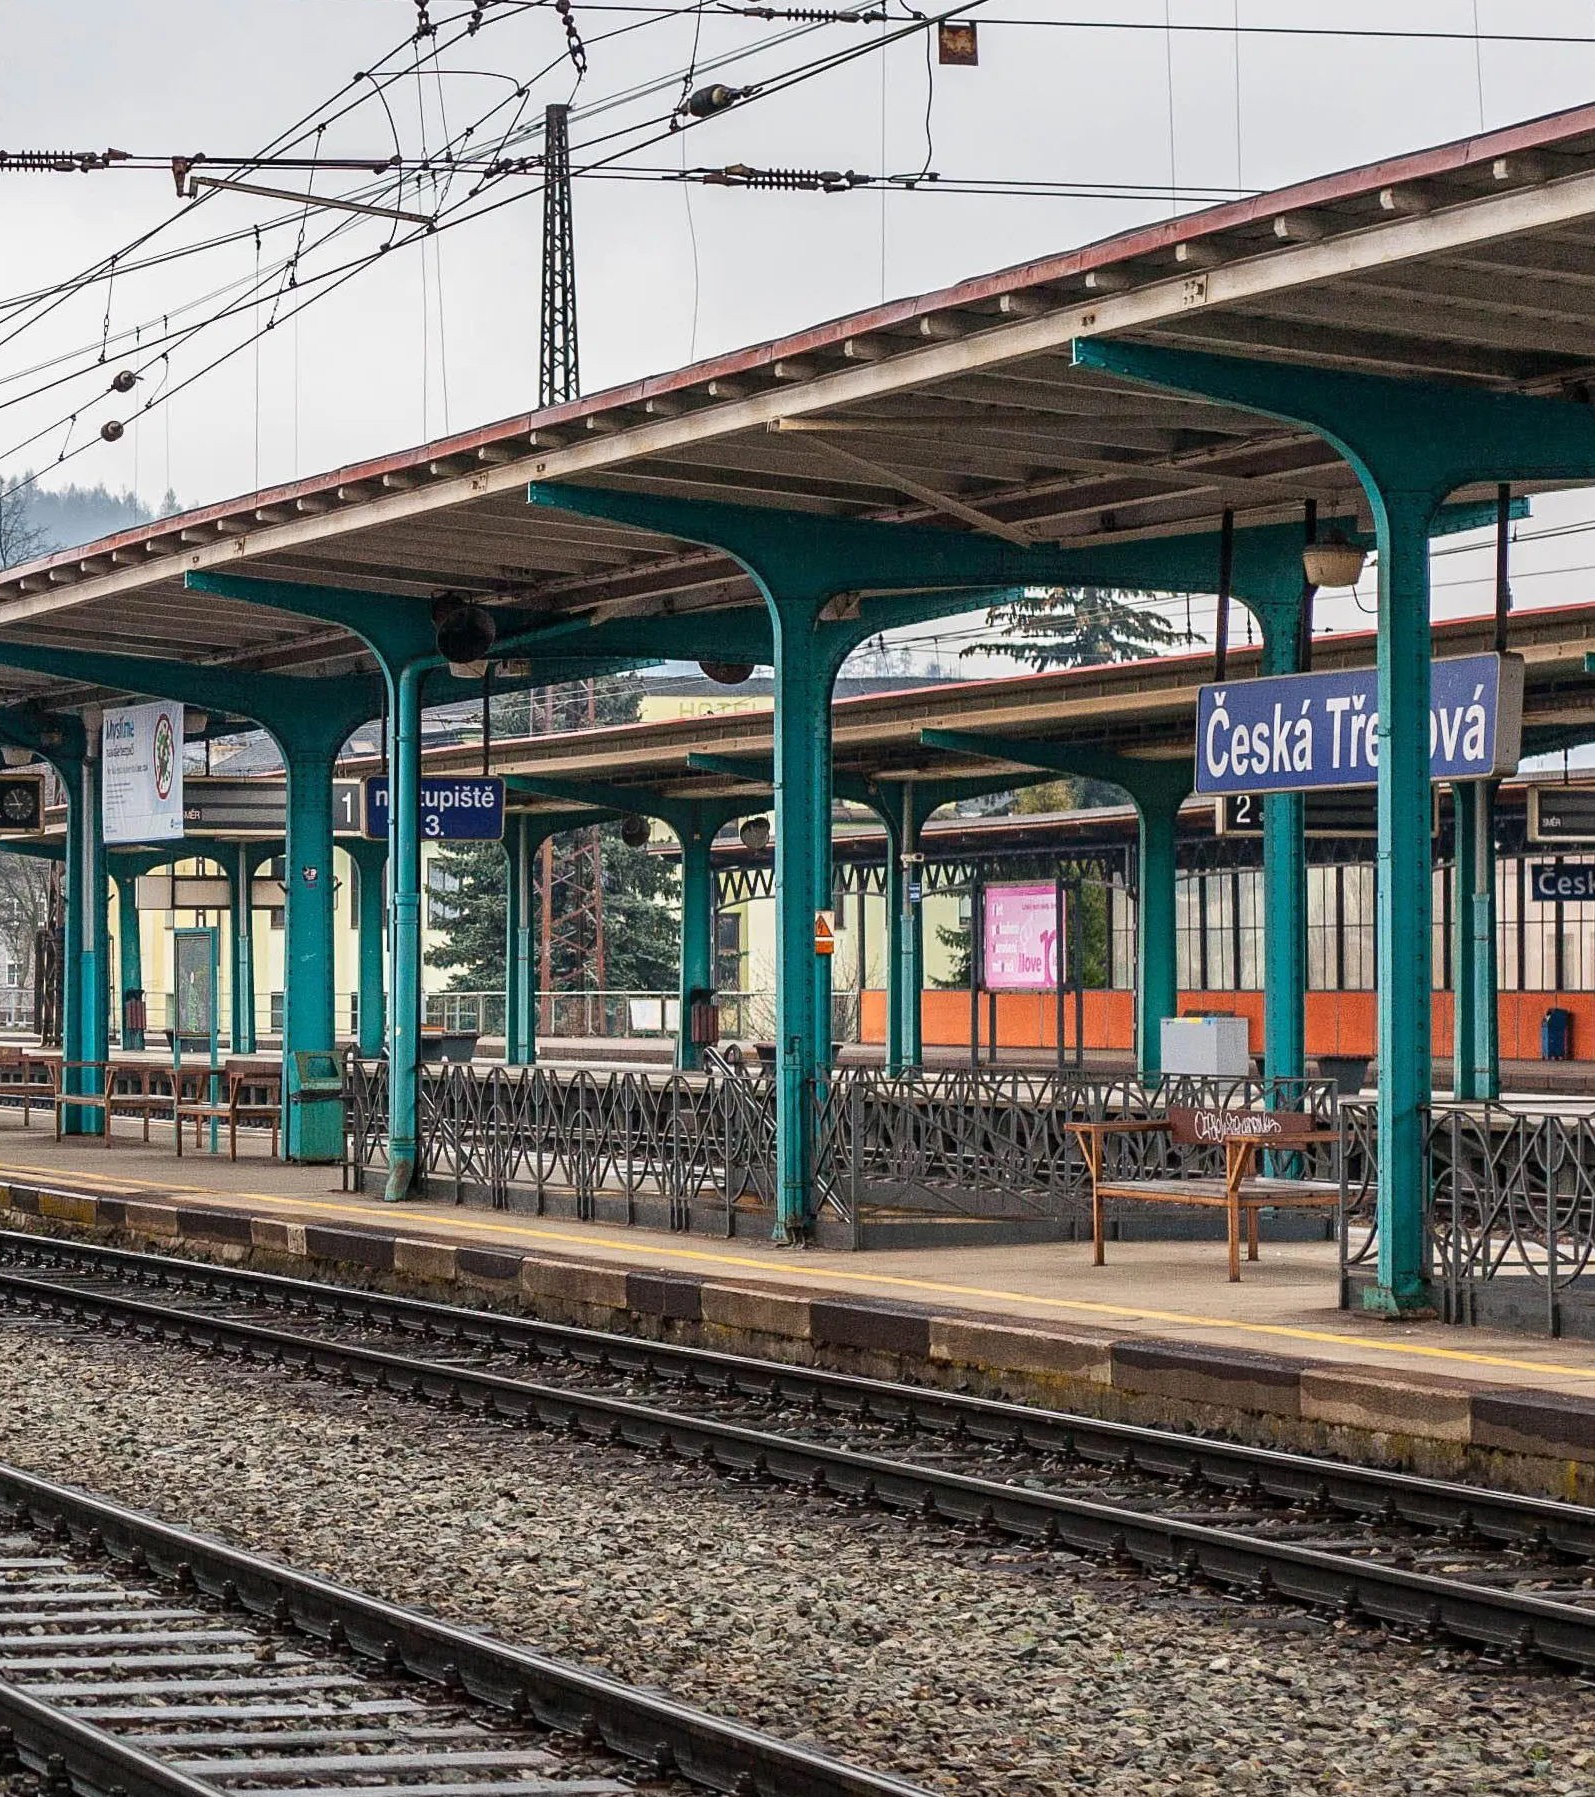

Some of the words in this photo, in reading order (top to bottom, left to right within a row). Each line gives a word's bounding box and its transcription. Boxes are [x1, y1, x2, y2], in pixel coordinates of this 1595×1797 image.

[1207, 691, 1313, 778] Česká
[1326, 684, 1487, 769] Třevá
[341, 792, 353, 823] 1
[375, 786, 495, 812] nupiště
[1236, 795, 1251, 823] 2
[184, 808, 201, 819] MĚR
[425, 815, 445, 836] 3.
